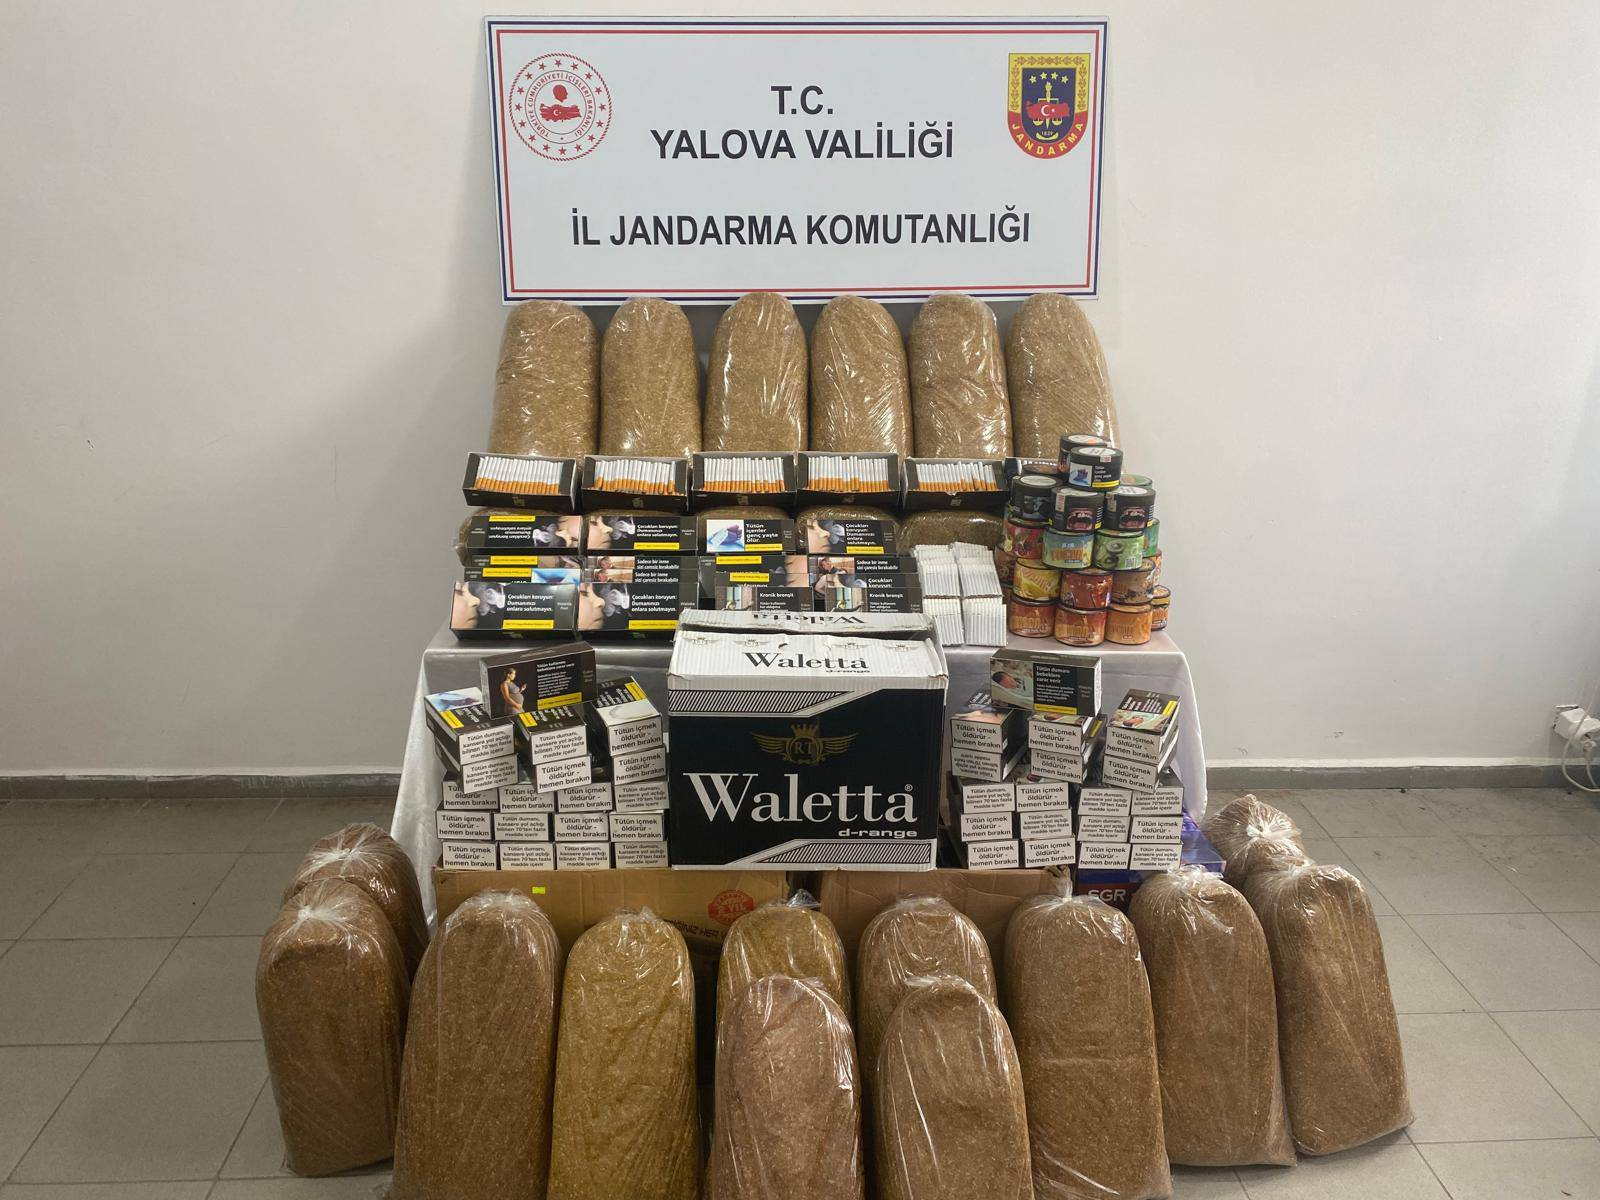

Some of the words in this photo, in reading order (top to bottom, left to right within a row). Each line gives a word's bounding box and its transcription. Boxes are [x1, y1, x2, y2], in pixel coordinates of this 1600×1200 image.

[770, 85, 834, 115] T.C.
[649, 129, 797, 160] YALOVA
[804, 120, 953, 159] VALİLİĞİ
[1012, 122, 1084, 156] JANDARMA
[572, 207, 601, 246] İL
[609, 215, 798, 246] JANDARMA
[806, 204, 1030, 245] KOMUTANLIĞI
[742, 652, 869, 669] Waletta
[683, 773, 918, 822] Waletta
[838, 828, 918, 839] d-range
[1088, 888, 1126, 902] SGR
